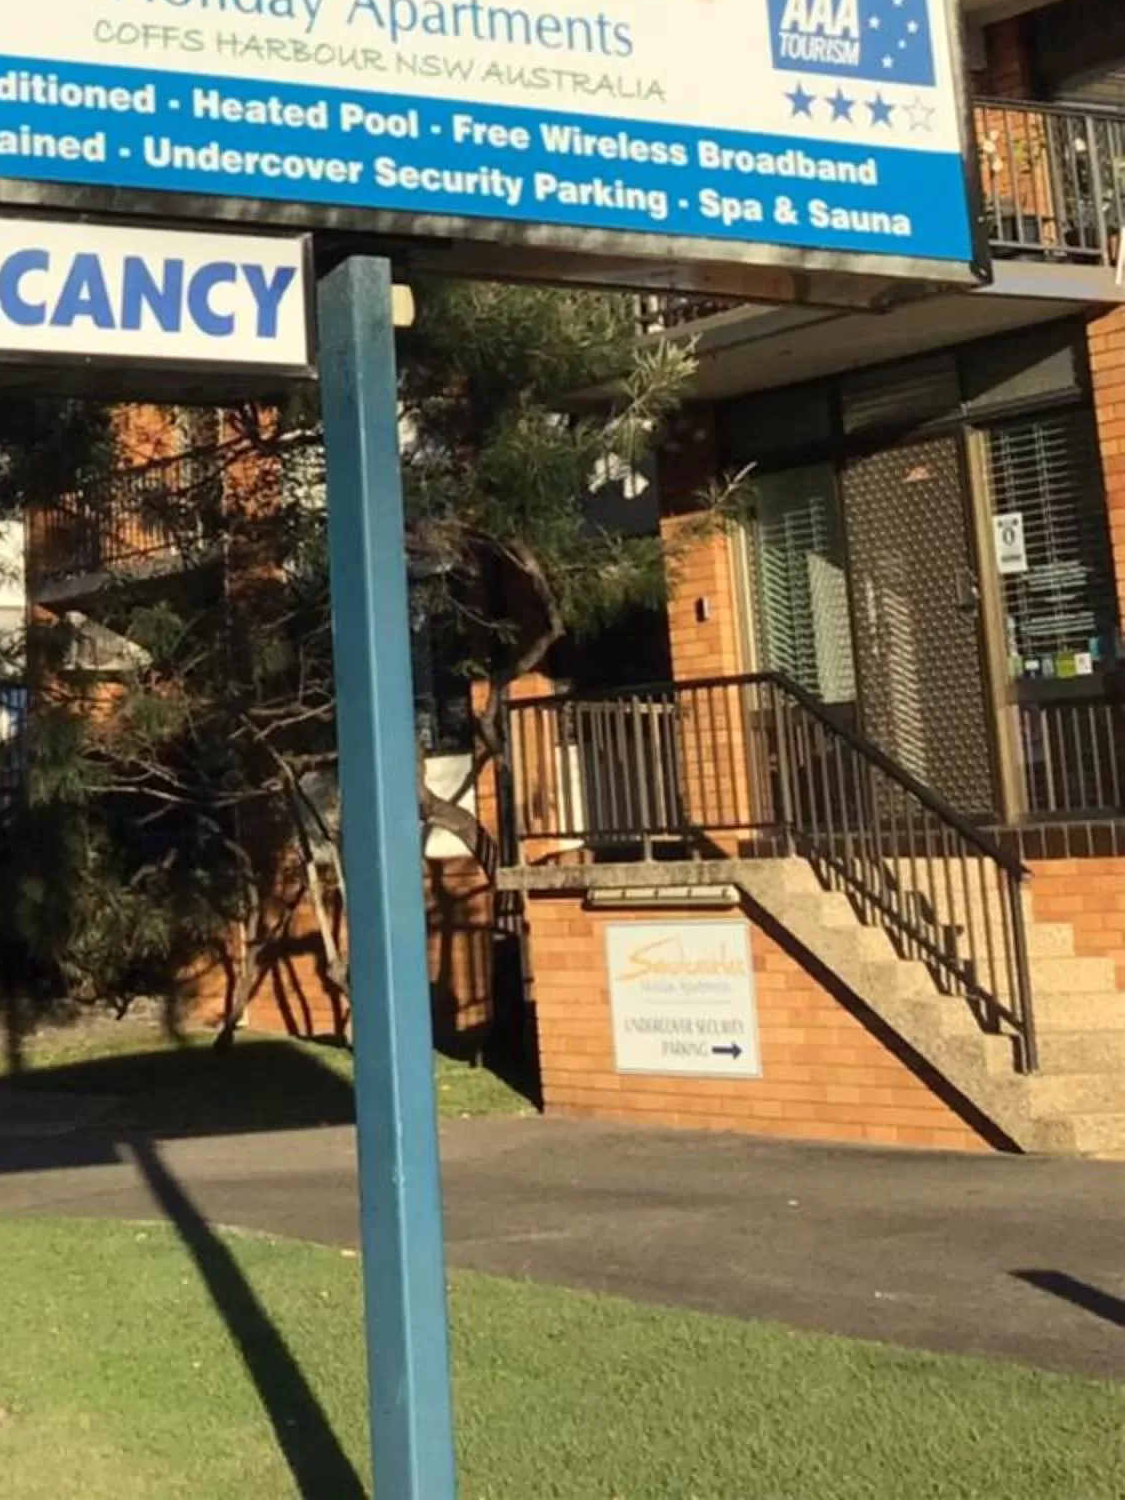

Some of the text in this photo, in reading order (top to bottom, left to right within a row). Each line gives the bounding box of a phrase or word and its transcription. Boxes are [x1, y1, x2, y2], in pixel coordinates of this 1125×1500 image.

[93, 19, 666, 103] COFFS HARBOUR NSW AUSTRALIA
[779, 32, 860, 66] TOURISM
[193, 88, 328, 131] Heated
[340, 102, 419, 139] Pool
[453, 113, 530, 150] Free
[540, 122, 688, 167] Wireless
[698, 140, 878, 186] Broadband
[144, 136, 363, 185] Undercover
[374, 155, 523, 207] Security
[534, 172, 669, 220] Parking
[699, 189, 763, 227] Spa
[773, 195, 800, 226] &
[808, 199, 913, 237] Sauna
